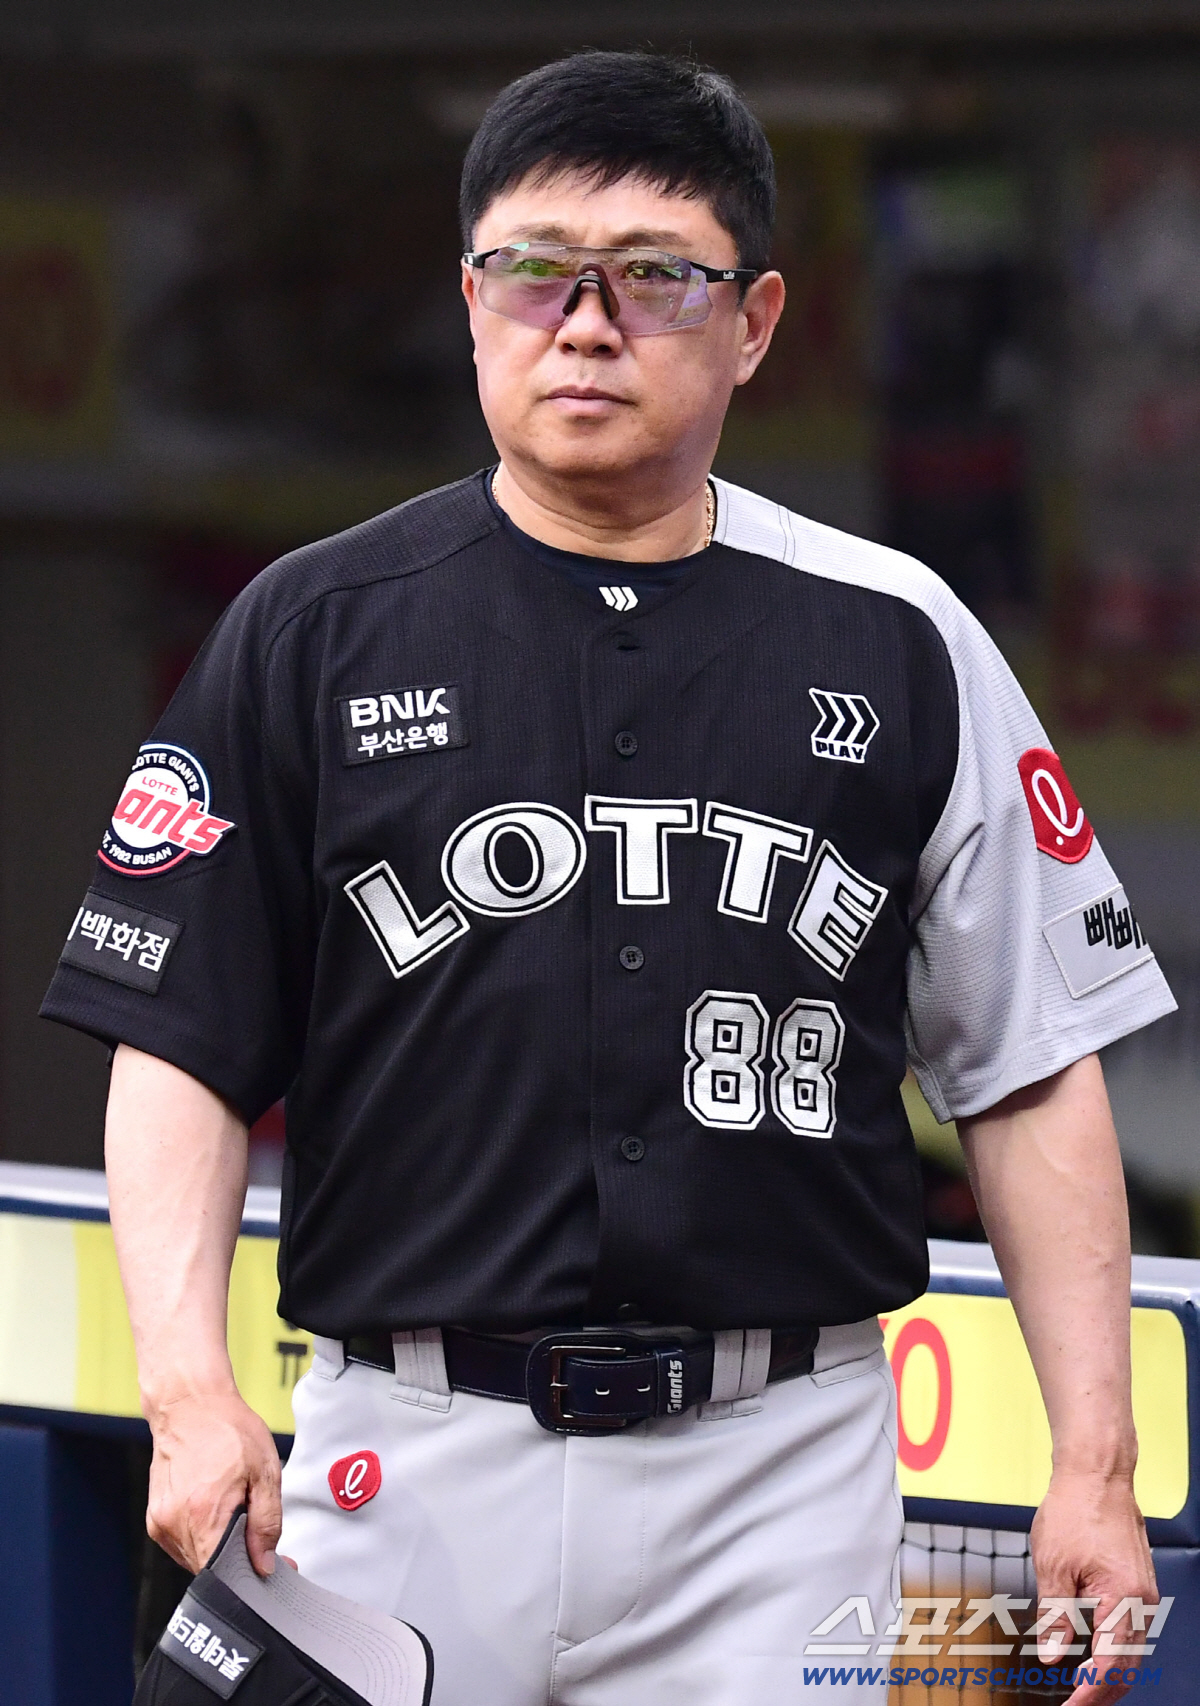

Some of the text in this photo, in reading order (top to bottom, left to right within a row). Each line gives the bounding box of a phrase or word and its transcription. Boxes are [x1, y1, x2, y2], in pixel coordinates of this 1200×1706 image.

[349, 688, 450, 728] BNK
[357, 722, 448, 757] 부산은행
[815, 740, 864, 760] PLAY
[142, 776, 179, 796] LOTTE
[168, 756, 200, 792] GIANTS
[109, 844, 132, 864] 1982
[132, 847, 172, 865] BUSAN
[344, 793, 888, 982] LOTTE
[683, 989, 845, 1139] 88
[667, 1359, 683, 1414] Giants
